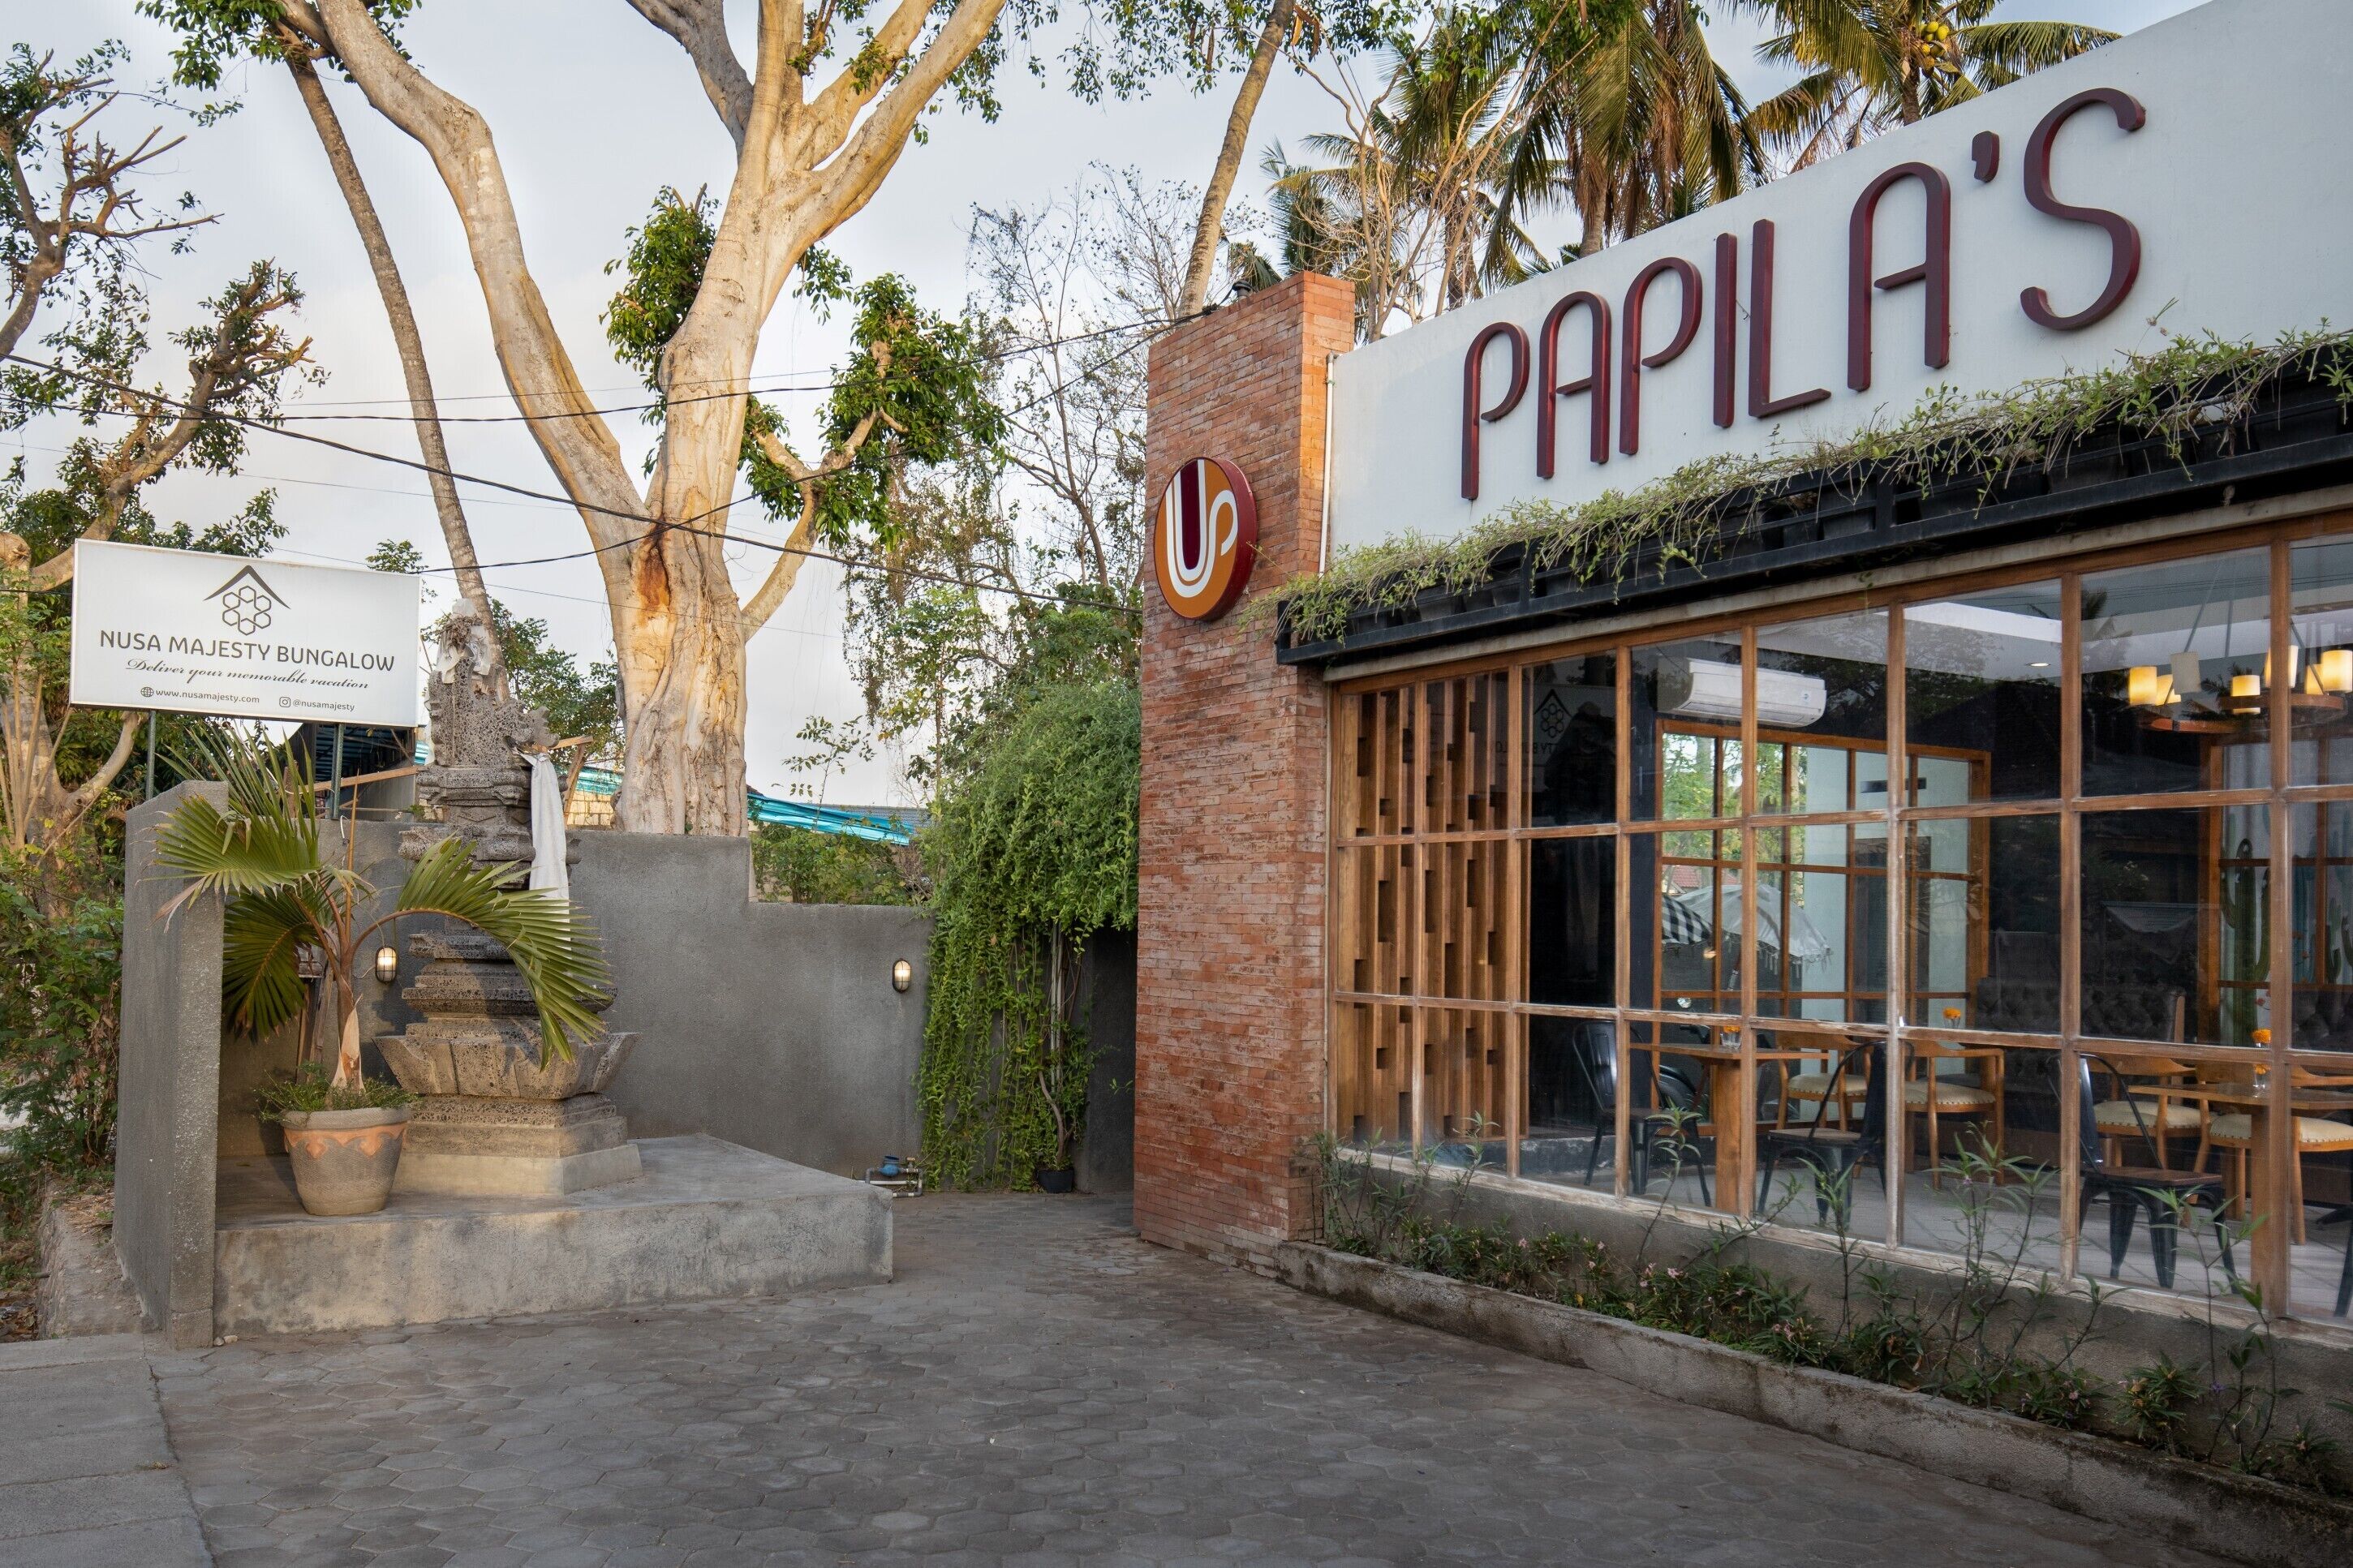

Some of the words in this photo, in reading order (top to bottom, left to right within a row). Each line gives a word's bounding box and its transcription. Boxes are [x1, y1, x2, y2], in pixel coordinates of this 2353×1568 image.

[1461, 88, 2146, 500] PAPILA'S
[100, 629, 161, 652] NUSA
[169, 636, 271, 661] MAJESTY
[277, 646, 395, 672] BUNGALOW
[125, 658, 184, 674] Deliver
[187, 668, 223, 684] your
[226, 668, 308, 685] memorable
[310, 679, 370, 689] vacation
[156, 689, 260, 703] www.nusamajesty.com
[292, 698, 355, 712] @nusamajesty
